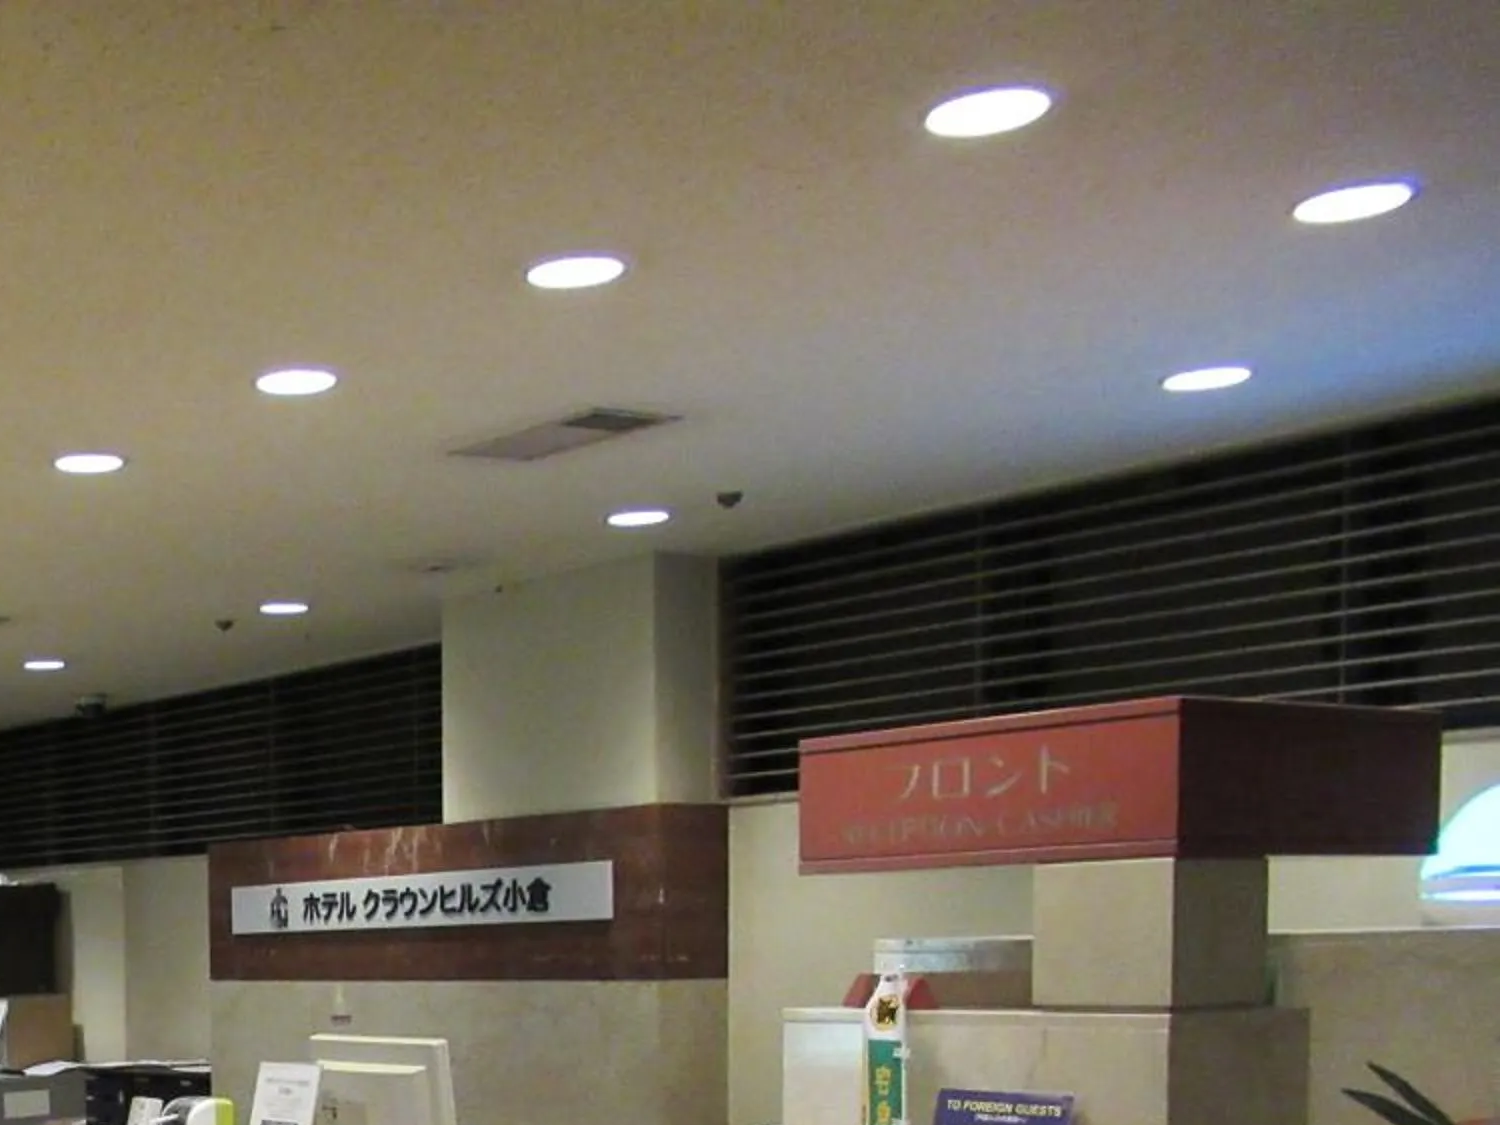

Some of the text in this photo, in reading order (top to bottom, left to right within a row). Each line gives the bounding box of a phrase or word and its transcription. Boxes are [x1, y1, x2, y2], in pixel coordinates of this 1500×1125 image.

[889, 744, 1071, 799] フロント
[302, 877, 552, 925] ホテル クラウンヒルズ小倉
[963, 1101, 1013, 1115] FOREIGN
[1015, 1104, 1062, 1118] GUESTS
